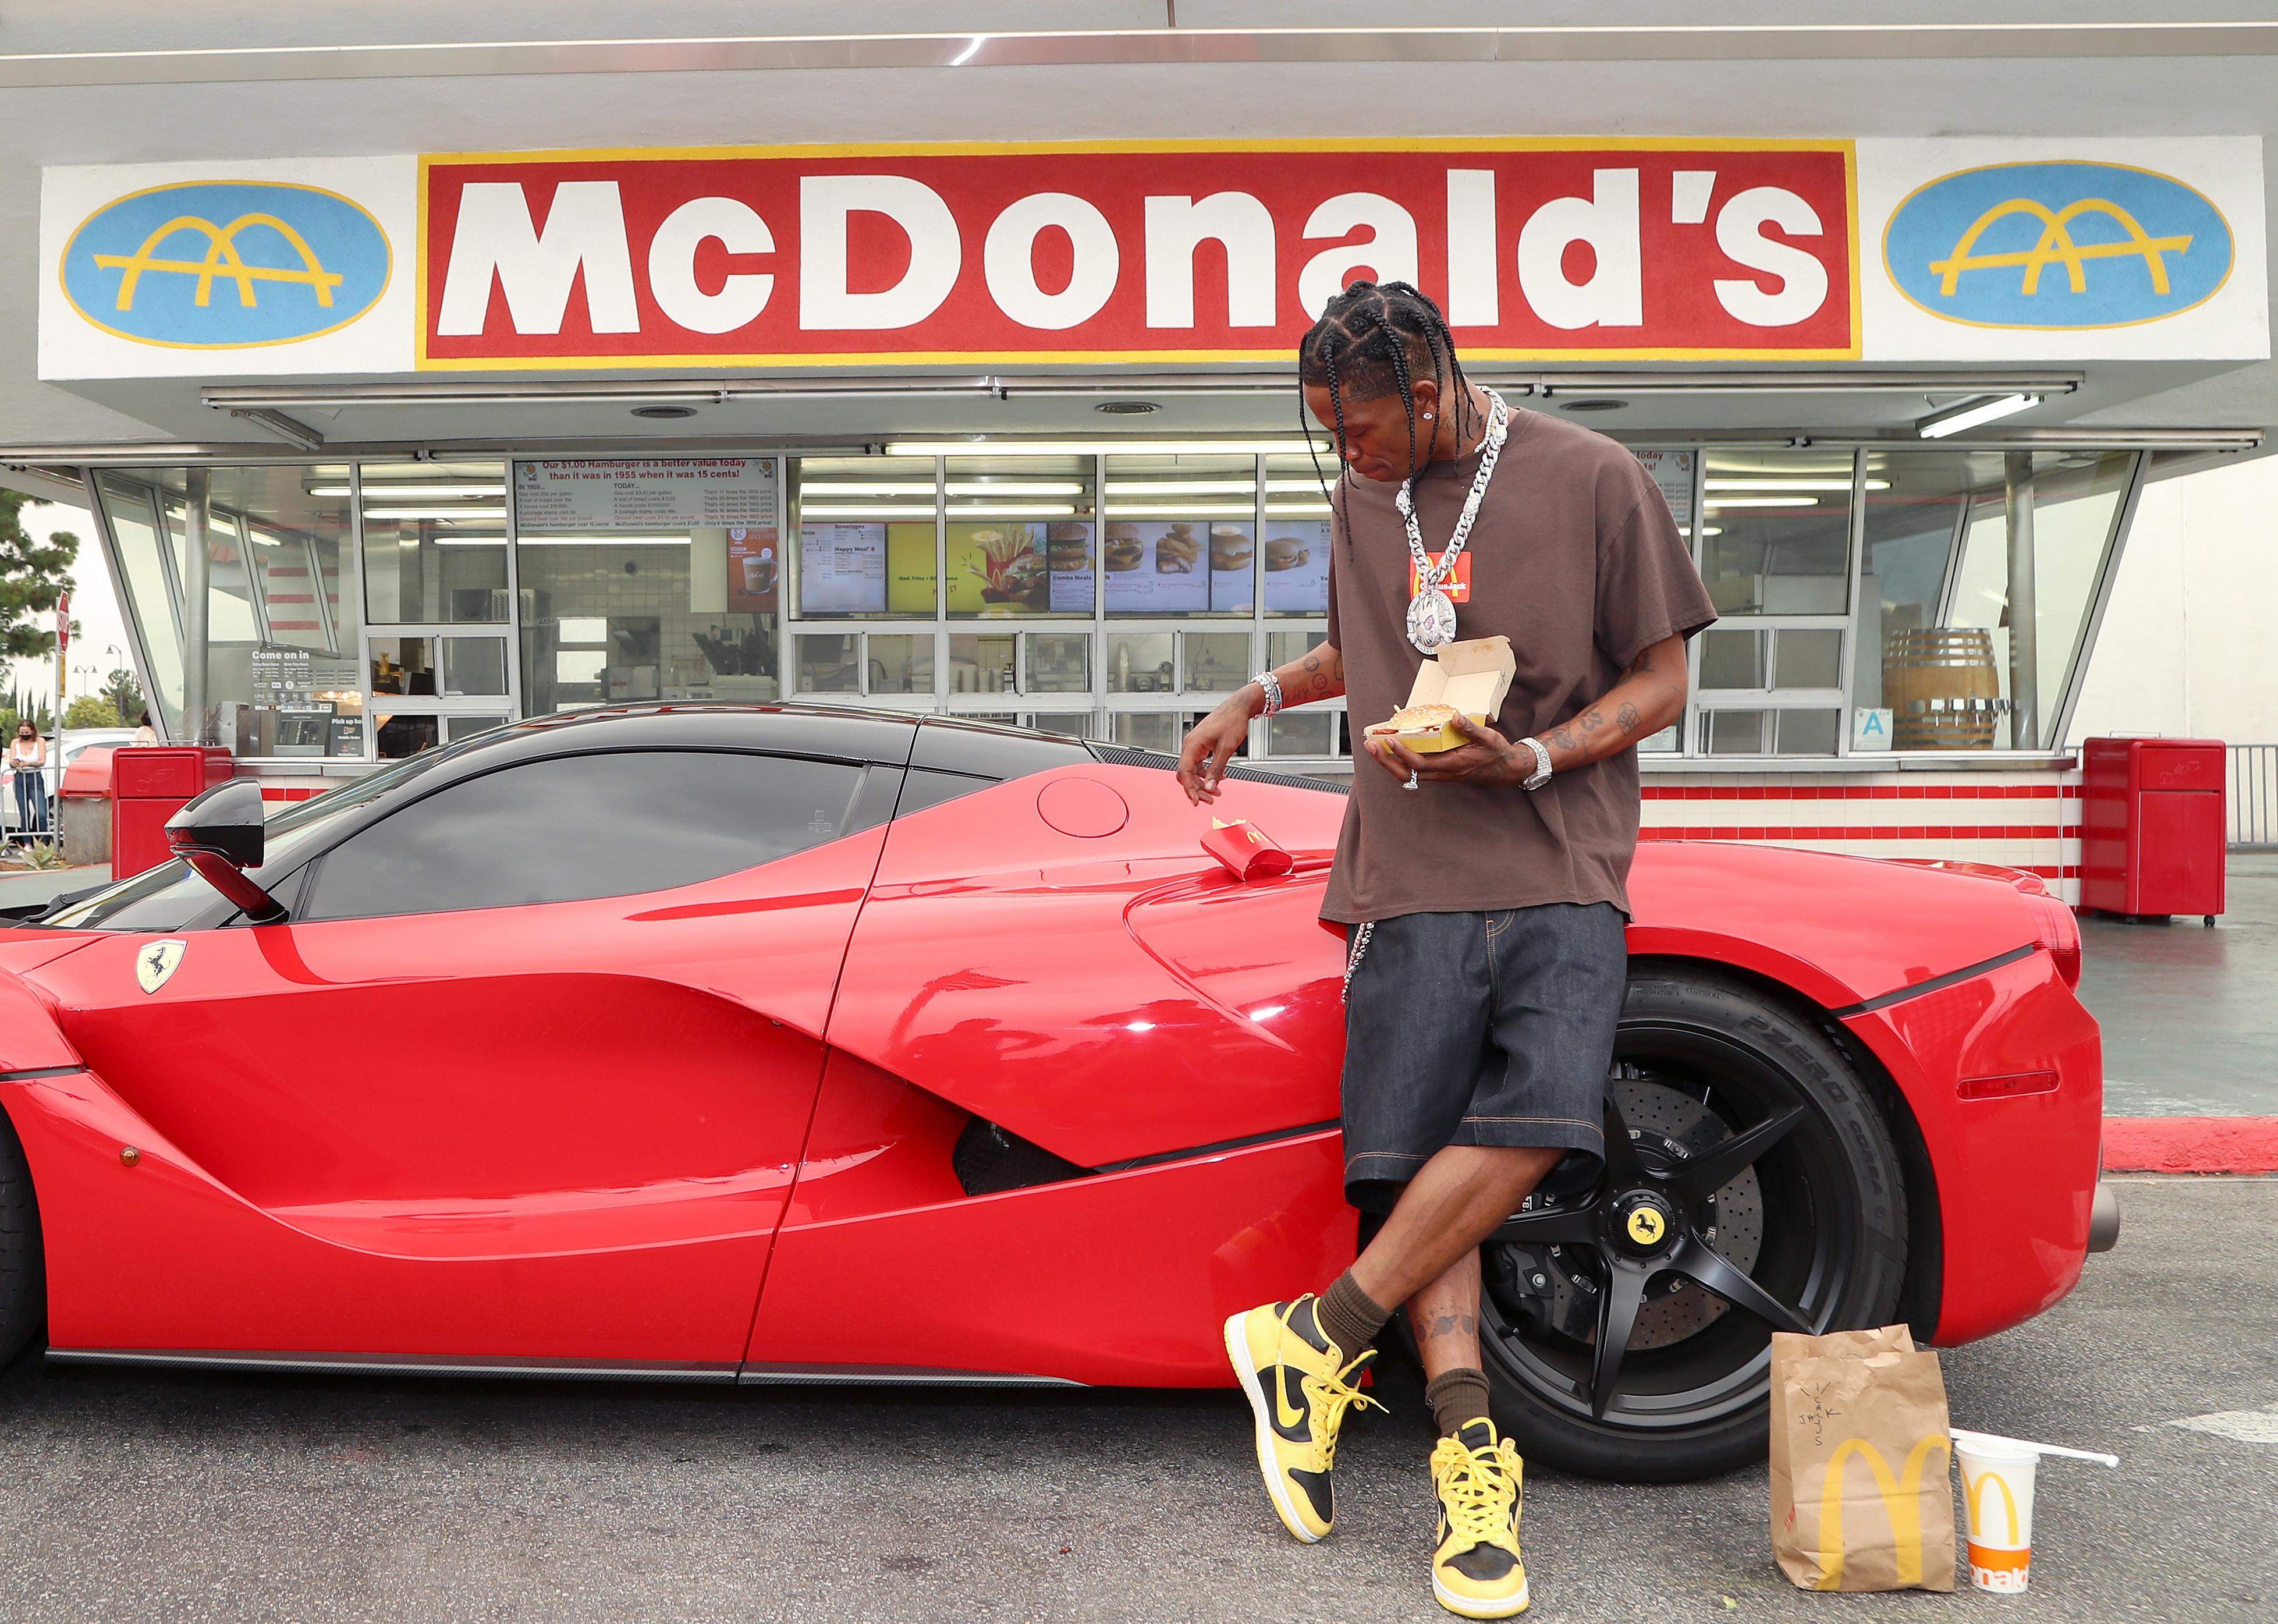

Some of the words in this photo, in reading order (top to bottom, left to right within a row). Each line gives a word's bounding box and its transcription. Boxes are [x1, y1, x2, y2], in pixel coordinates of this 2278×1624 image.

[437, 168, 1828, 336] McDonald's
[1637, 451, 1663, 460] today
[561, 460, 586, 469] $1.00
[588, 460, 640, 469] Hamburger
[720, 459, 746, 467] today
[615, 471, 636, 479] 1955
[711, 470, 740, 478] cents!
[252, 651, 282, 659] Come
[299, 650, 309, 659] in
[1862, 711, 1884, 735] A
